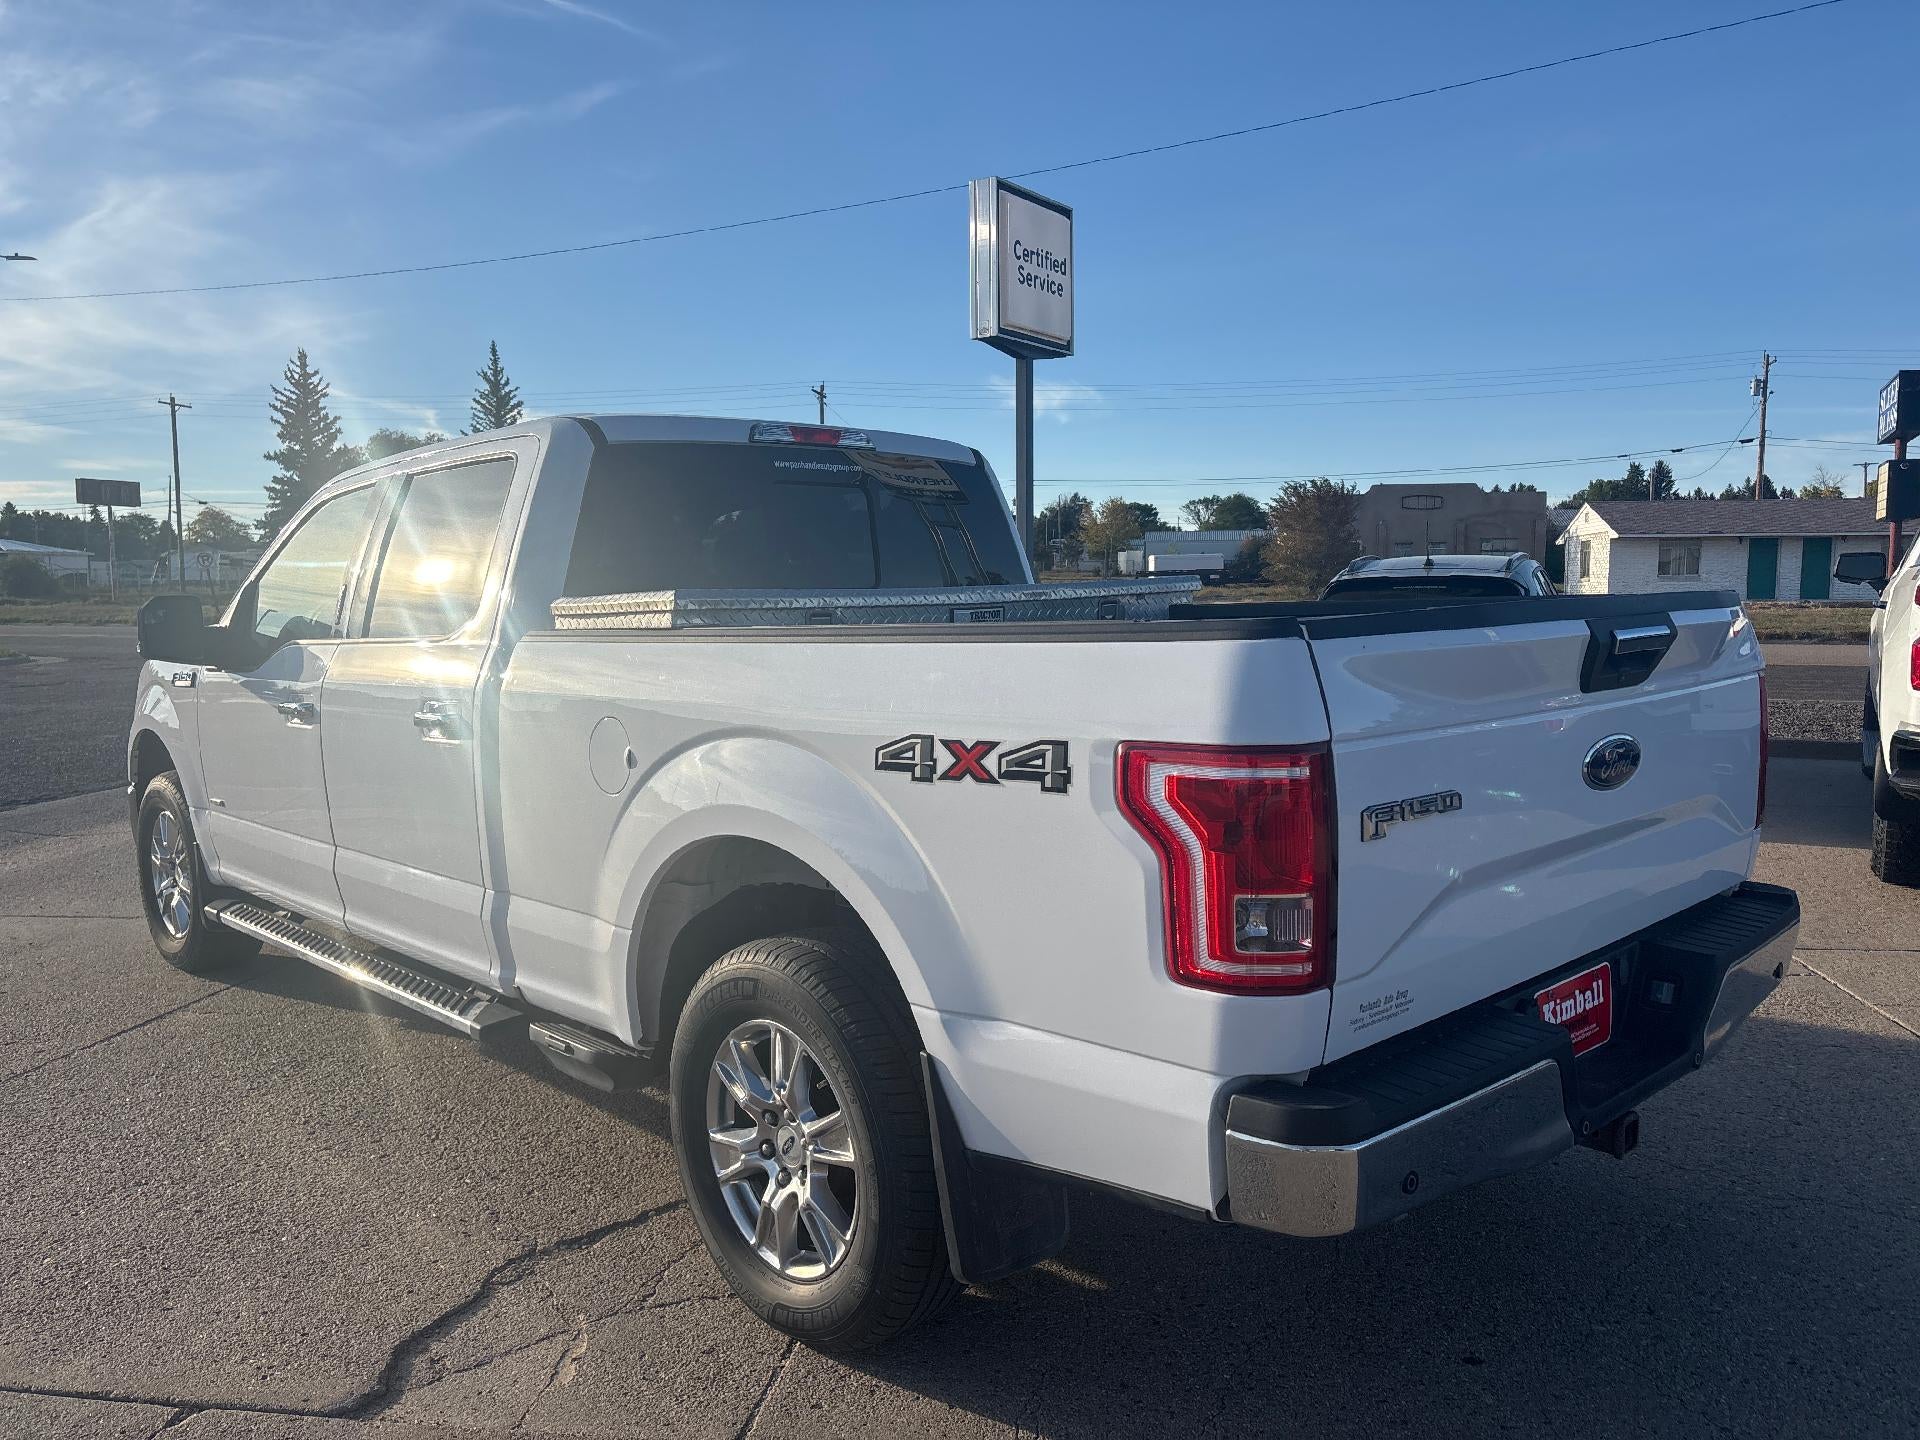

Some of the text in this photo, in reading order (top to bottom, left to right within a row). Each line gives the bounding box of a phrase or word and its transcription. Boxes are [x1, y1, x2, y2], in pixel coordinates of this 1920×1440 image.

[1013, 239, 1067, 276] Certified
[1017, 264, 1064, 298] Service
[1600, 746, 1634, 780] Ford
[1543, 979, 1604, 1025] Kimball
[822, 1044, 842, 1074] LTX
